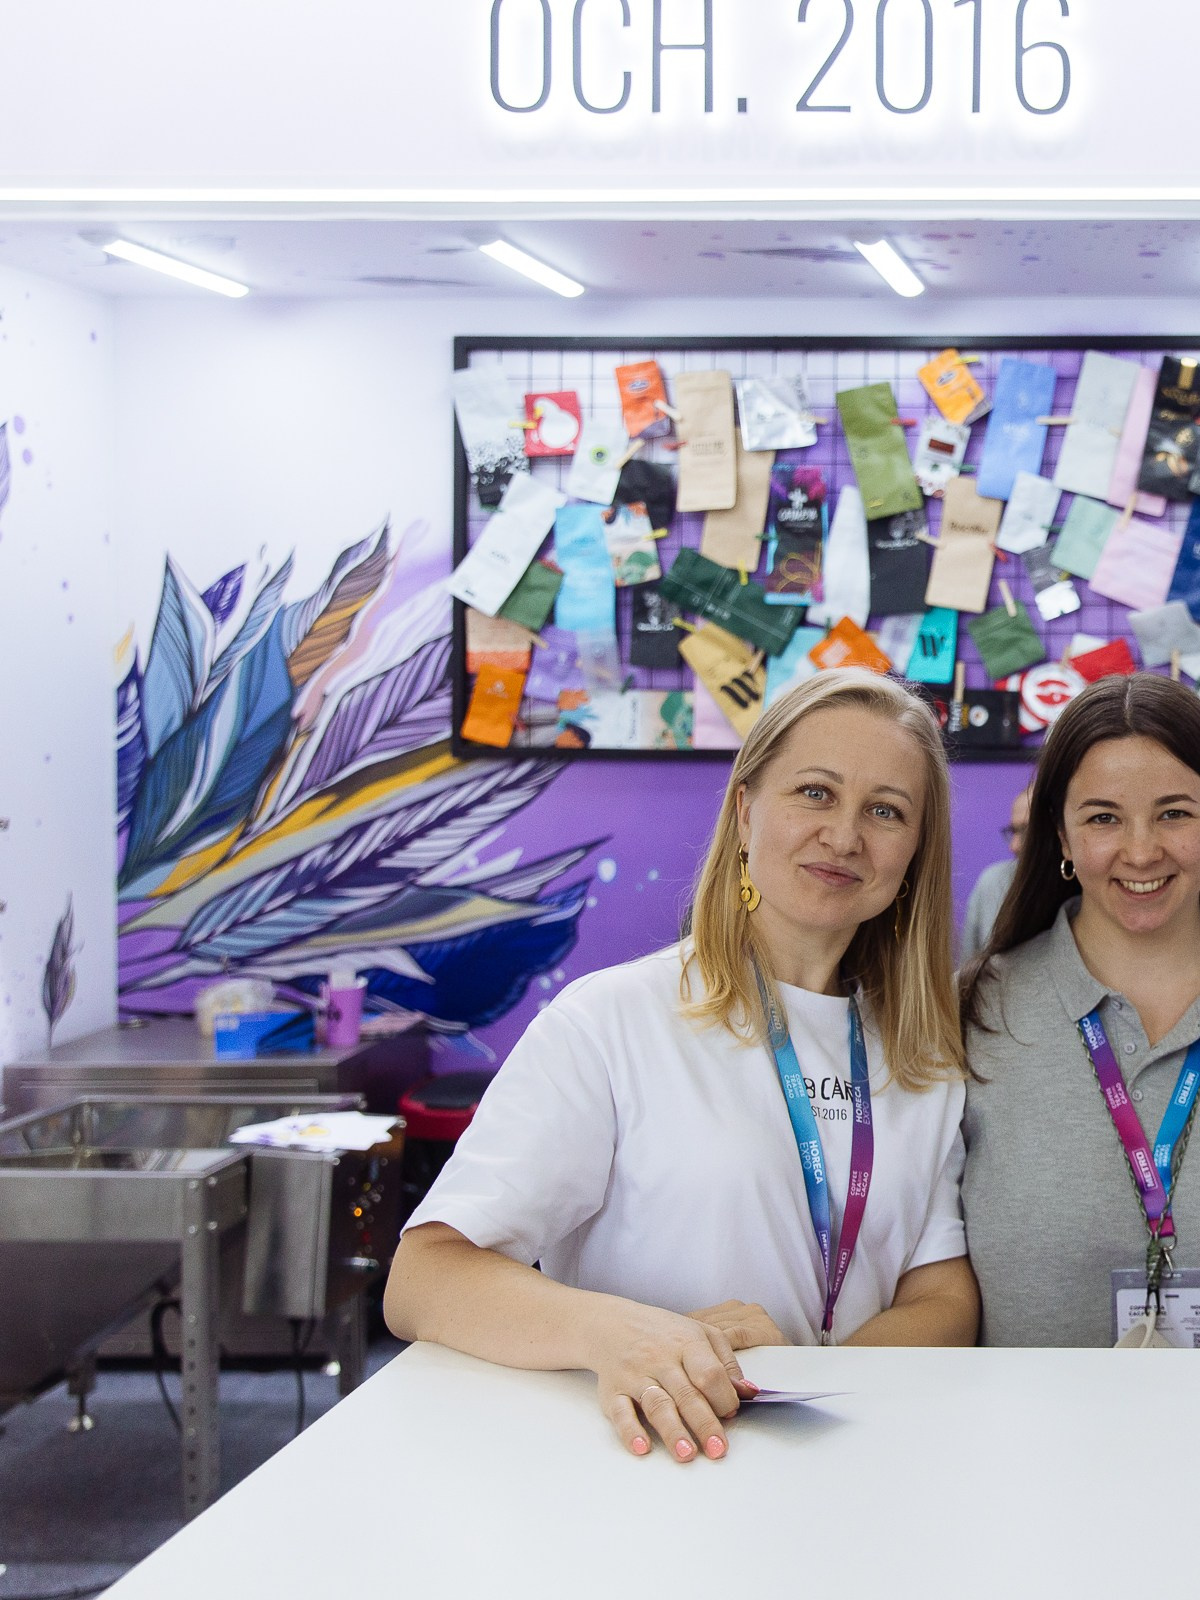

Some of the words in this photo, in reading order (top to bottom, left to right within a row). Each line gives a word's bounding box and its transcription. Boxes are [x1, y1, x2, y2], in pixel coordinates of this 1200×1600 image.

[795, 0, 1072, 116] 2016
[1082, 1017, 1100, 1051] HOREC
[784, 1075, 795, 1099] CACAO
[1178, 1071, 1196, 1105] METRO
[855, 1085, 863, 1124] HORECA
[862, 1101, 871, 1125] EXPO
[799, 1141, 812, 1170] EXPO
[808, 1140, 824, 1185] HORECA
[1136, 1150, 1156, 1188] METRO
[850, 1170, 858, 1196] COFFEE
[860, 1171, 869, 1197] CACAO
